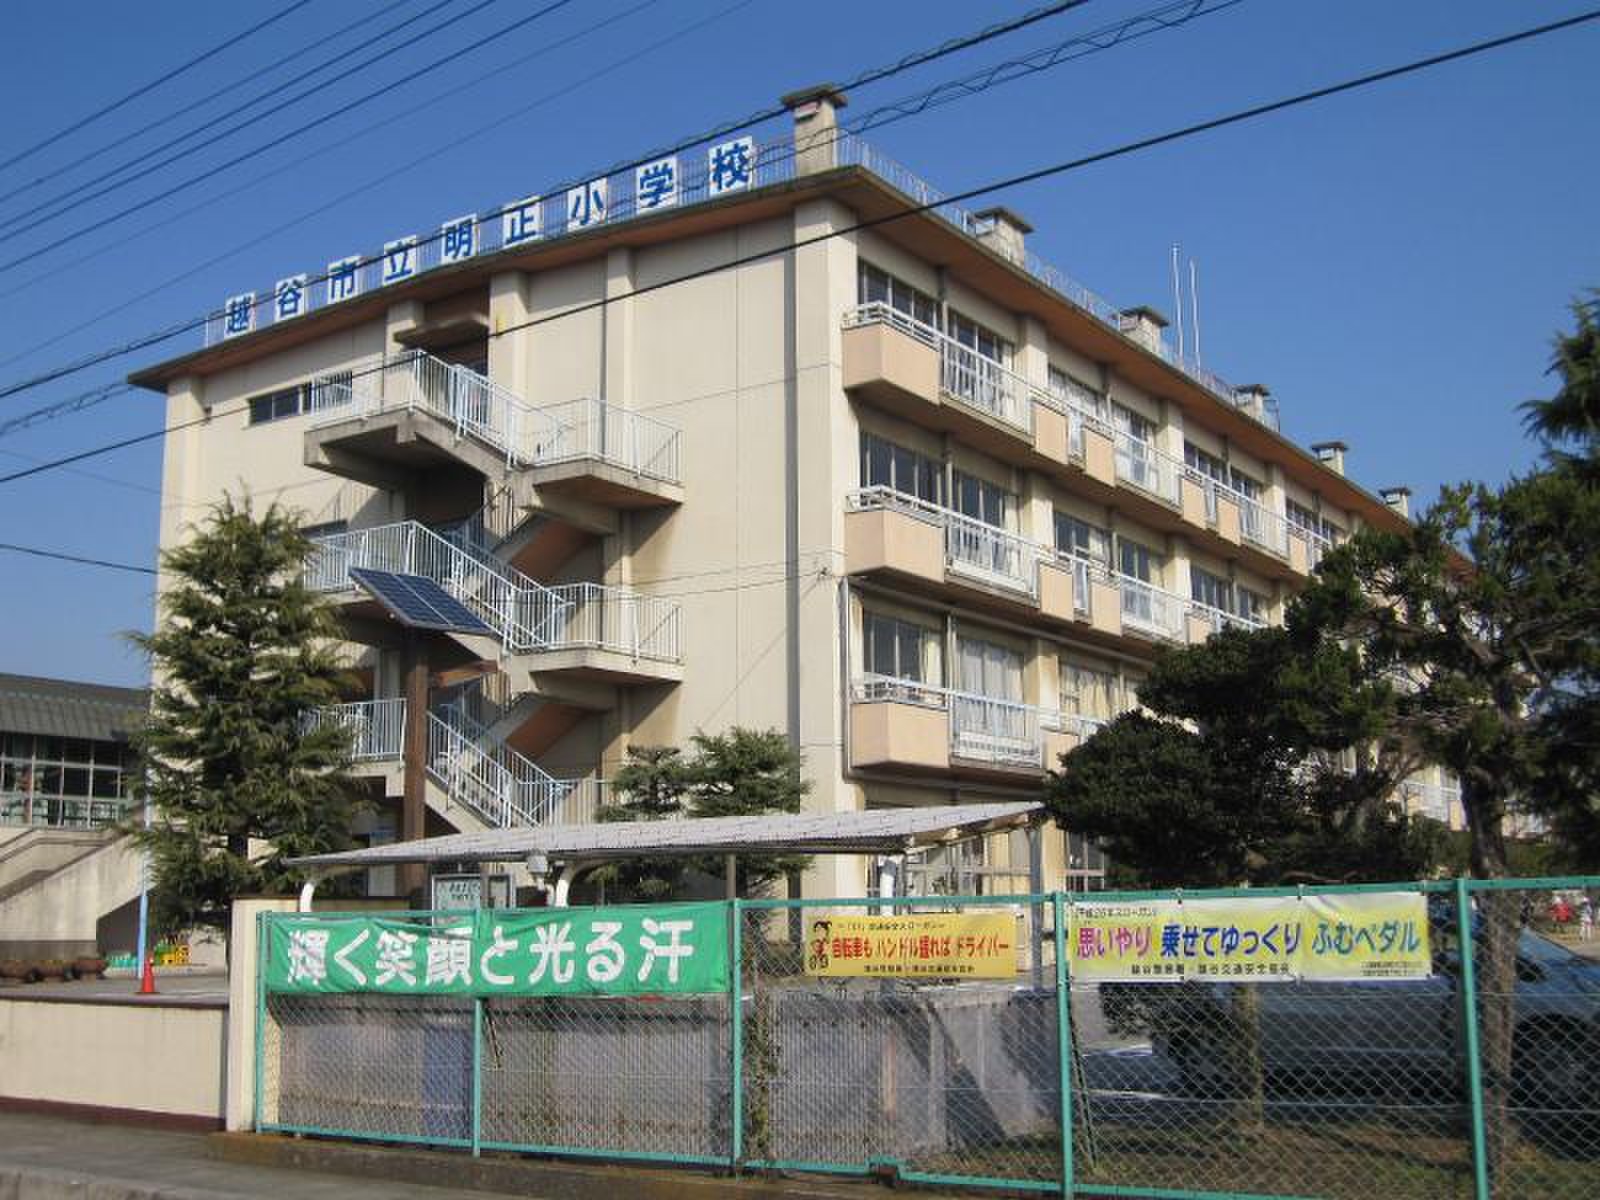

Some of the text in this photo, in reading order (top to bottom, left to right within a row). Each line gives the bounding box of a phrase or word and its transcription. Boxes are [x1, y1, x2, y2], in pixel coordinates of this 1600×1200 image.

[225, 140, 752, 334] 越谷市立明正小学校
[287, 917, 695, 987] 輝く笑顔と光る汗
[832, 937, 872, 959] 自転車も
[957, 934, 1009, 957] ドライバー
[1076, 919, 1421, 959] 思いやり 乗せてゆっくり ふむペダル
